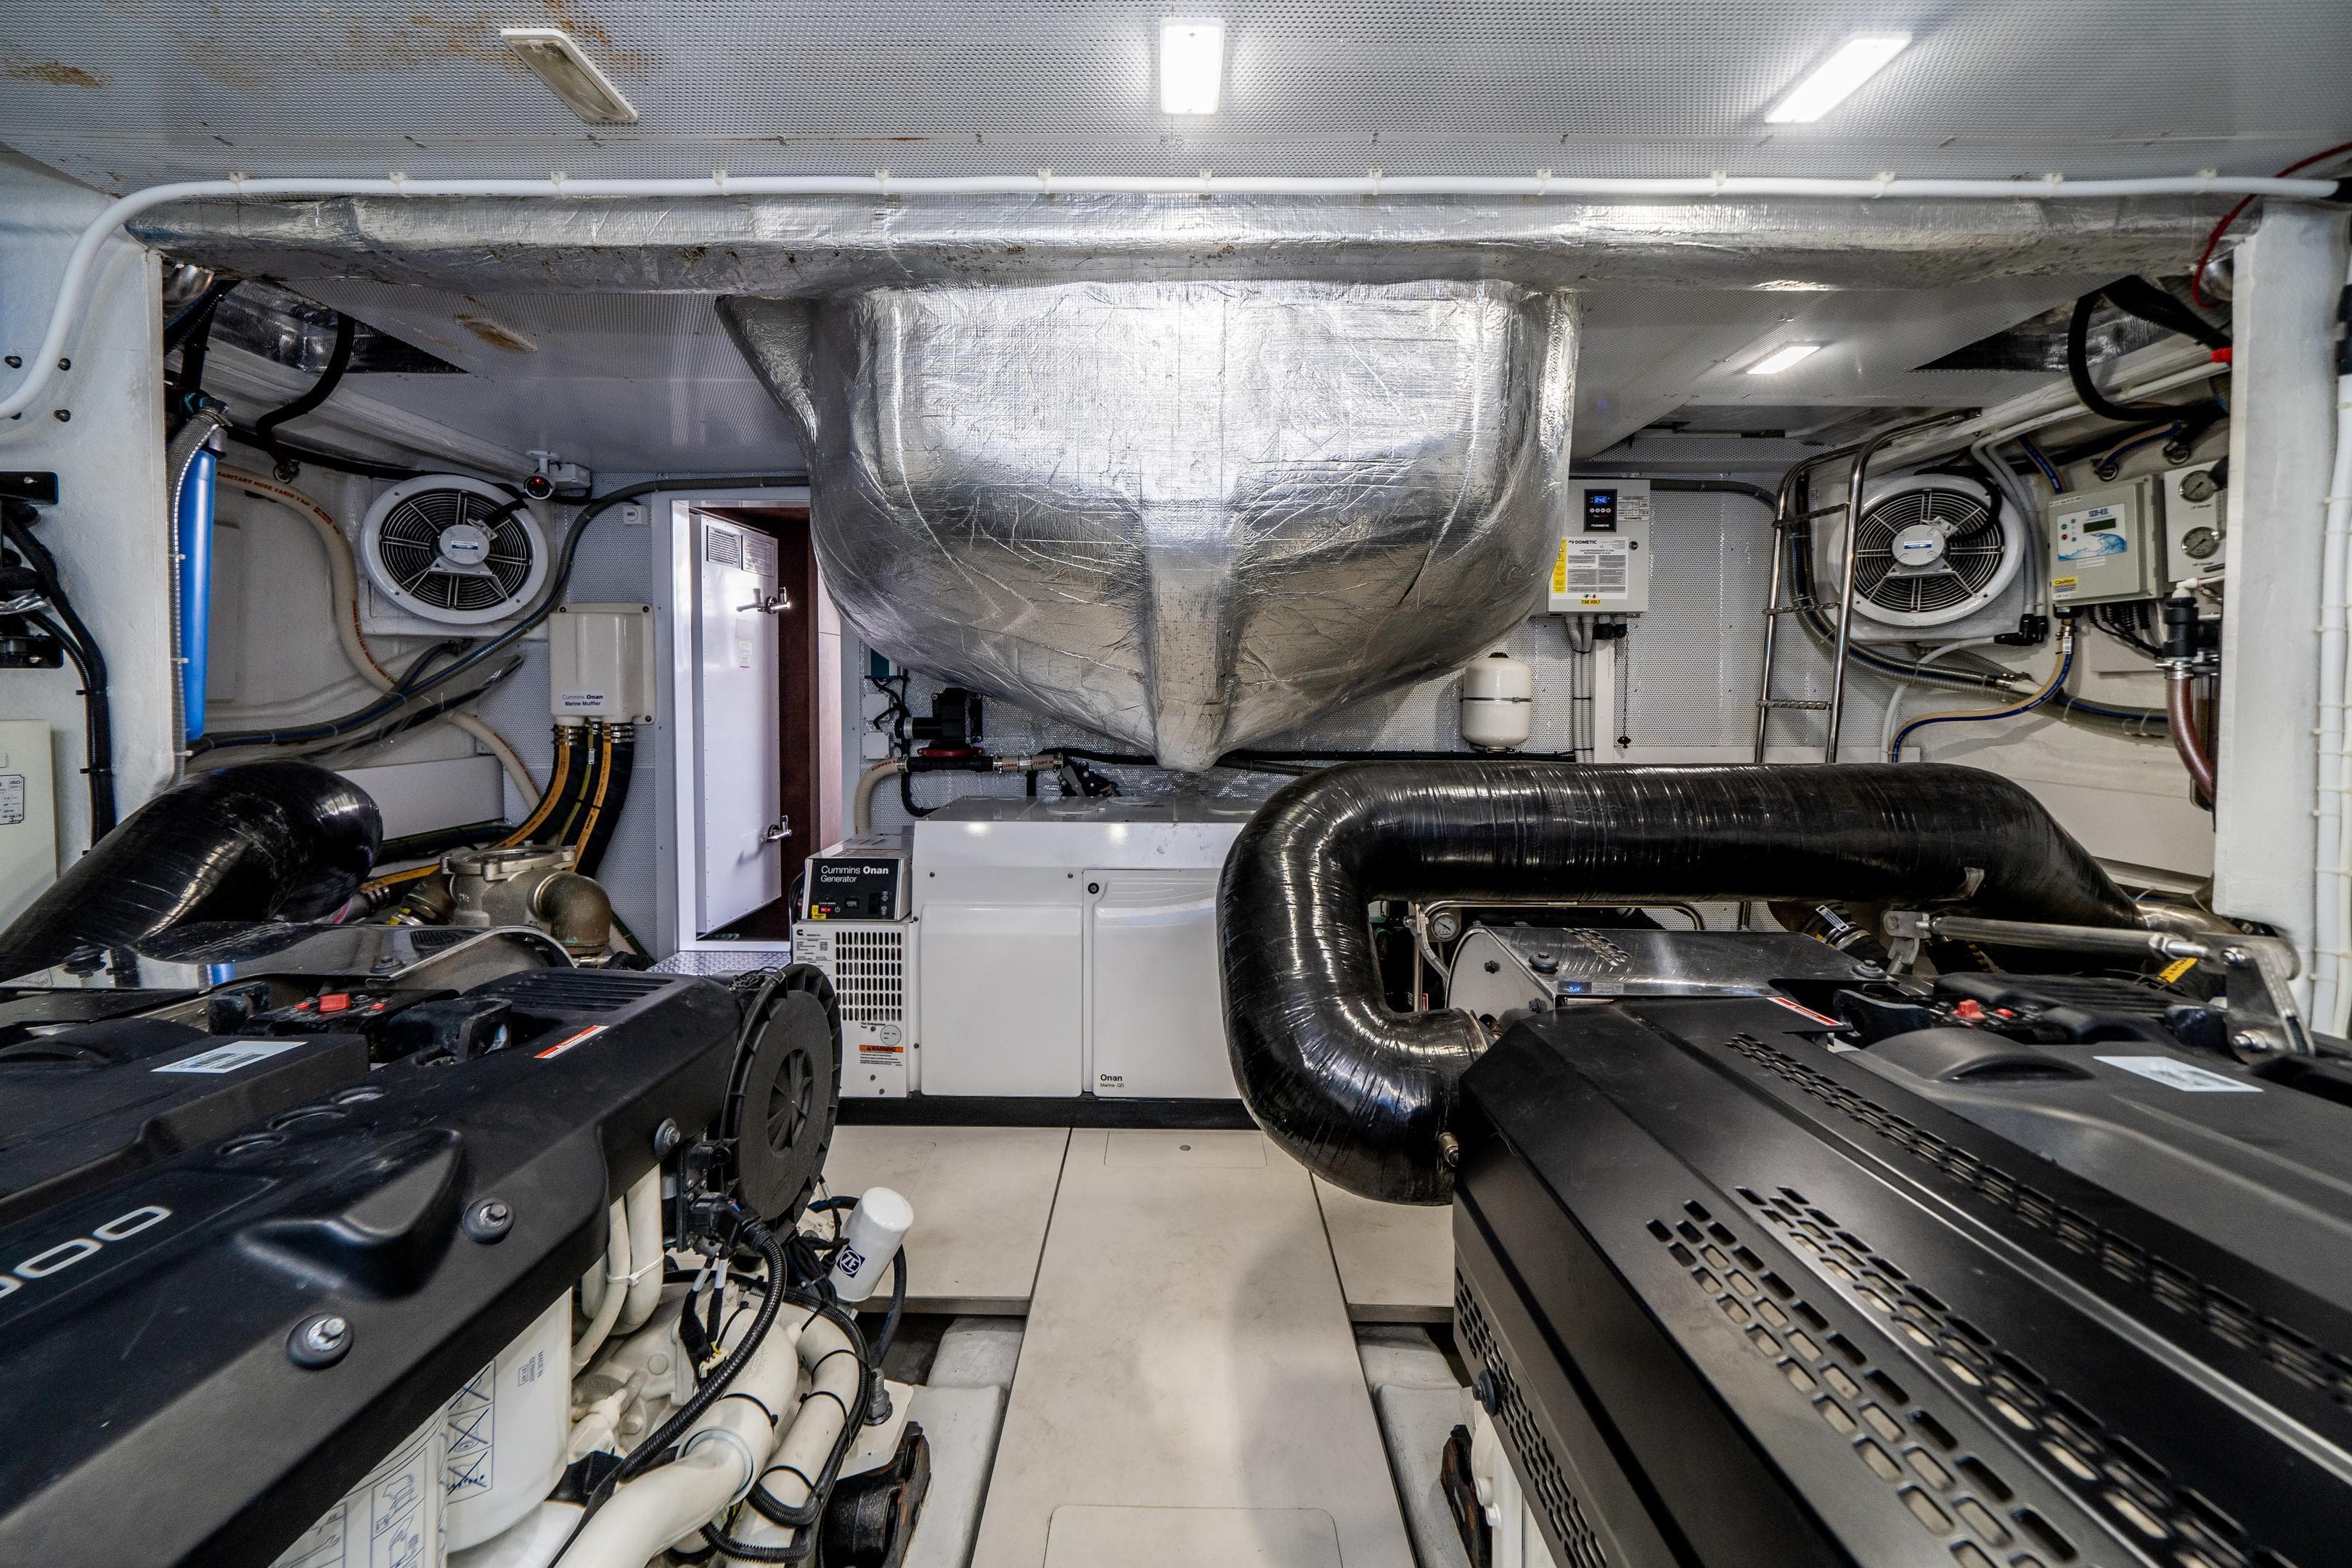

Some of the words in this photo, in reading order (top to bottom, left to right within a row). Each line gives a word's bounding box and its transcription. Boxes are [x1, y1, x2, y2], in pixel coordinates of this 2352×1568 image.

[217, 471, 253, 484] SANITARY
[254, 481, 273, 491] HOSE
[274, 487, 295, 499] VARIO
[820, 875, 857, 883] Generator
[821, 865, 861, 875] Cummins
[863, 866, 889, 875] Onan
[0, 1206, 173, 1299] 00
[840, 1250, 861, 1274] ZF
